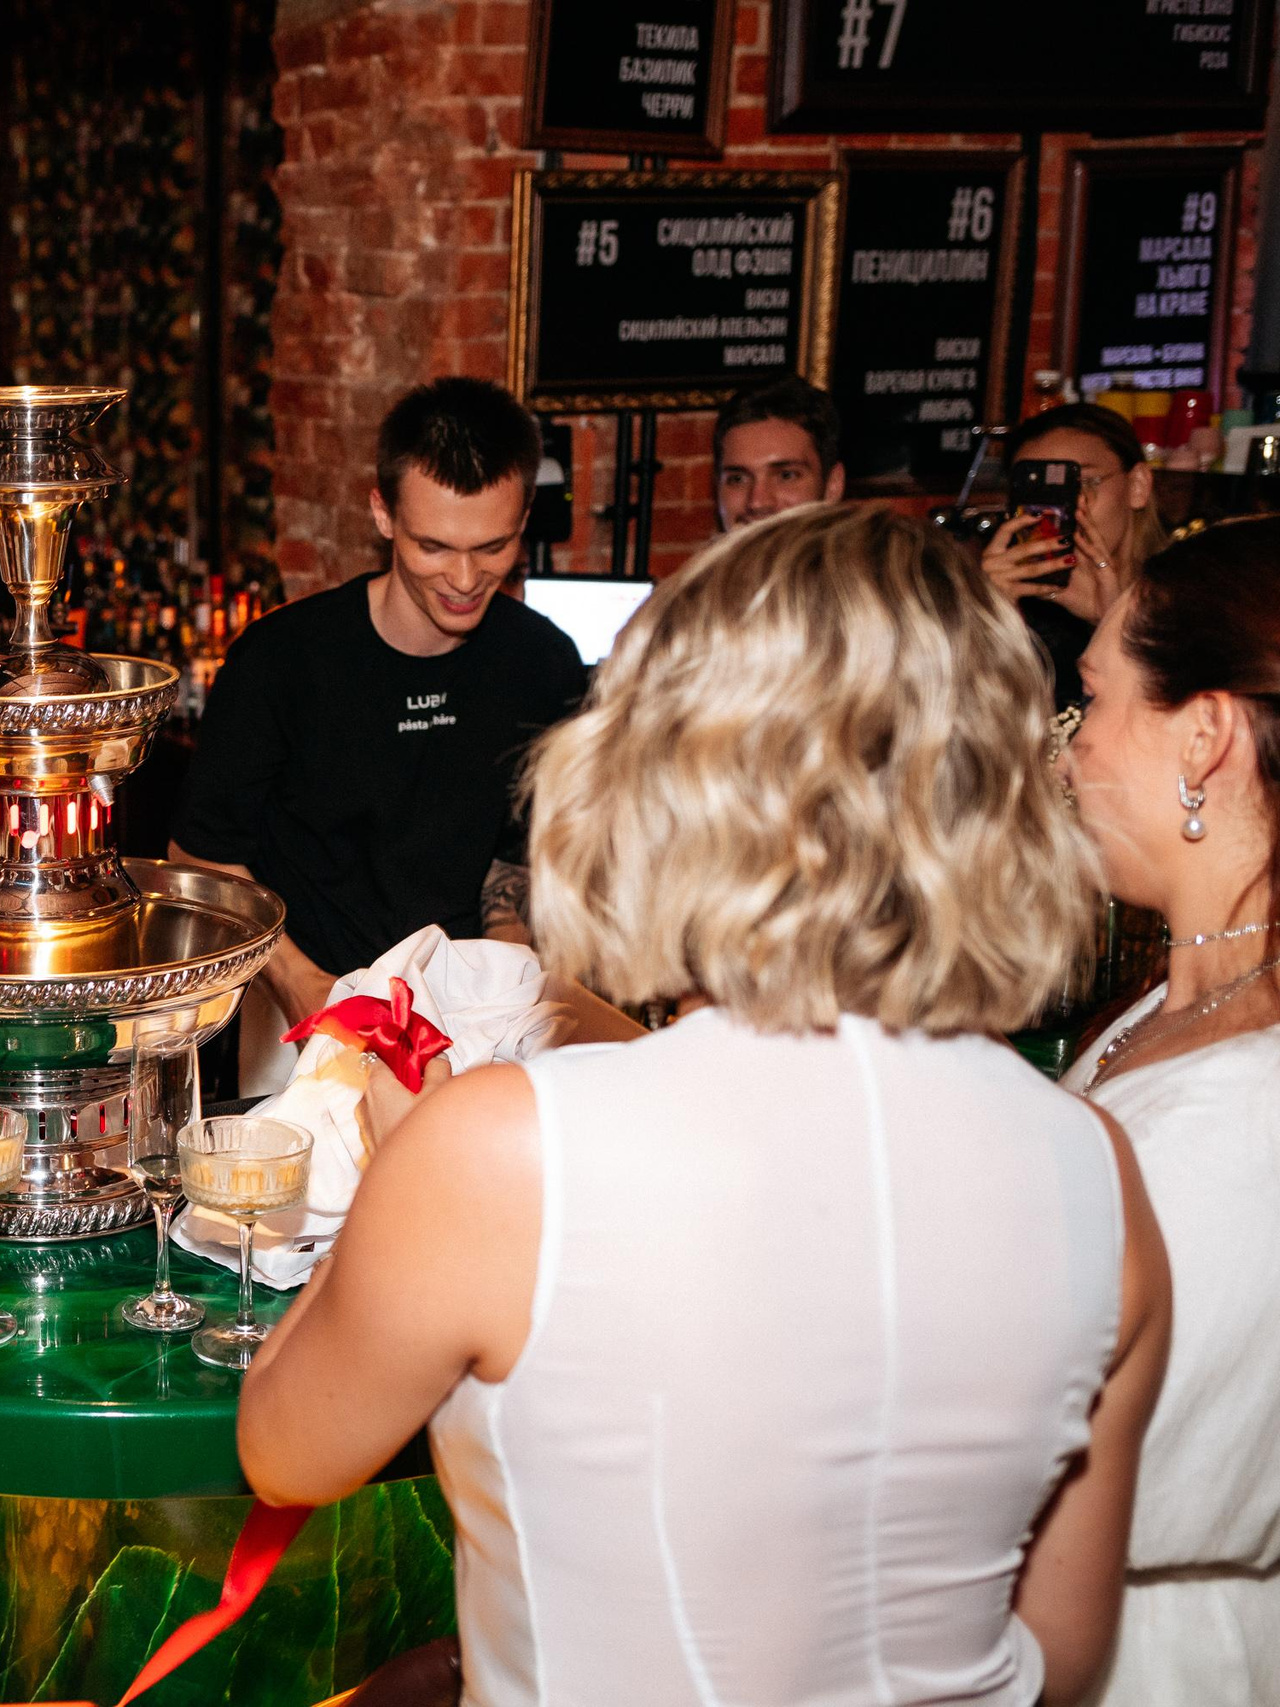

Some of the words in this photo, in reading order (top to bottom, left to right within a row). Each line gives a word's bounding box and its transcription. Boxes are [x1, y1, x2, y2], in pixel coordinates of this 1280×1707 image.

[636, 22, 700, 50] ТЕКИЛА
[837, 0, 908, 69] #7
[619, 56, 697, 85] БАЗИЛИК
[641, 92, 695, 119] ЧЕРРИ
[948, 186, 994, 242] #6
[1181, 192, 1217, 232] #9
[576, 220, 619, 266] #5
[657, 212, 794, 247] СИЦИЛИЙСКИЙ
[1139, 236, 1213, 262] МАРСАЛА
[692, 248, 733, 279] ОЛД
[734, 248, 792, 275] ФЭШН
[851, 249, 990, 285] ПЕНИЦИЛЛИН
[1156, 264, 1212, 289] ХЬЮГО
[745, 288, 790, 310] ВИСКИ
[1135, 293, 1157, 318] НА
[1159, 291, 1209, 316] КРАНЕ
[618, 315, 718, 342] СИЦИЛИЙСКИЙ
[719, 316, 788, 338] АПЕЛЬСИН
[723, 344, 786, 366] МАРСАЛА
